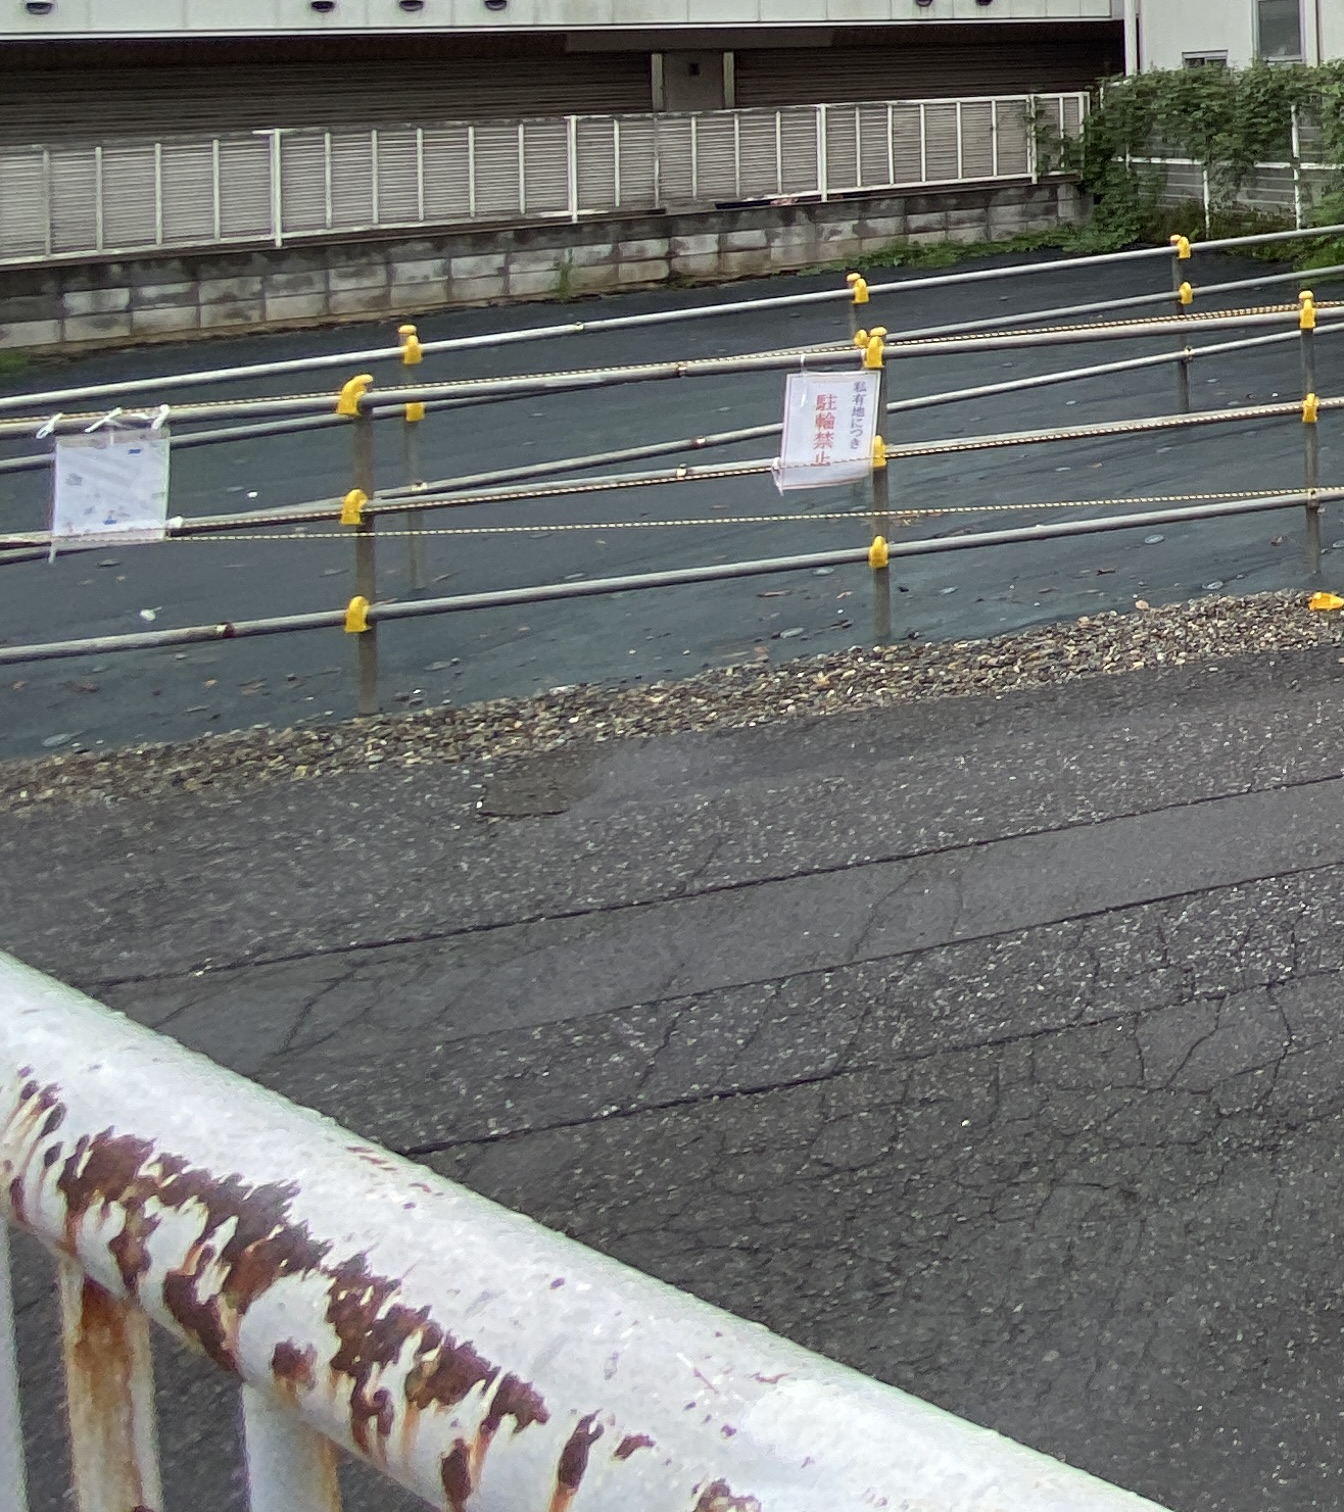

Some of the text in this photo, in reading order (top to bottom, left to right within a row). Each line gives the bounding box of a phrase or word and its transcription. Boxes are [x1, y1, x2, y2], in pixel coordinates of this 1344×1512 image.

[811, 393, 837, 466] 駐輪禁止
[850, 381, 866, 450] 私有地につき
